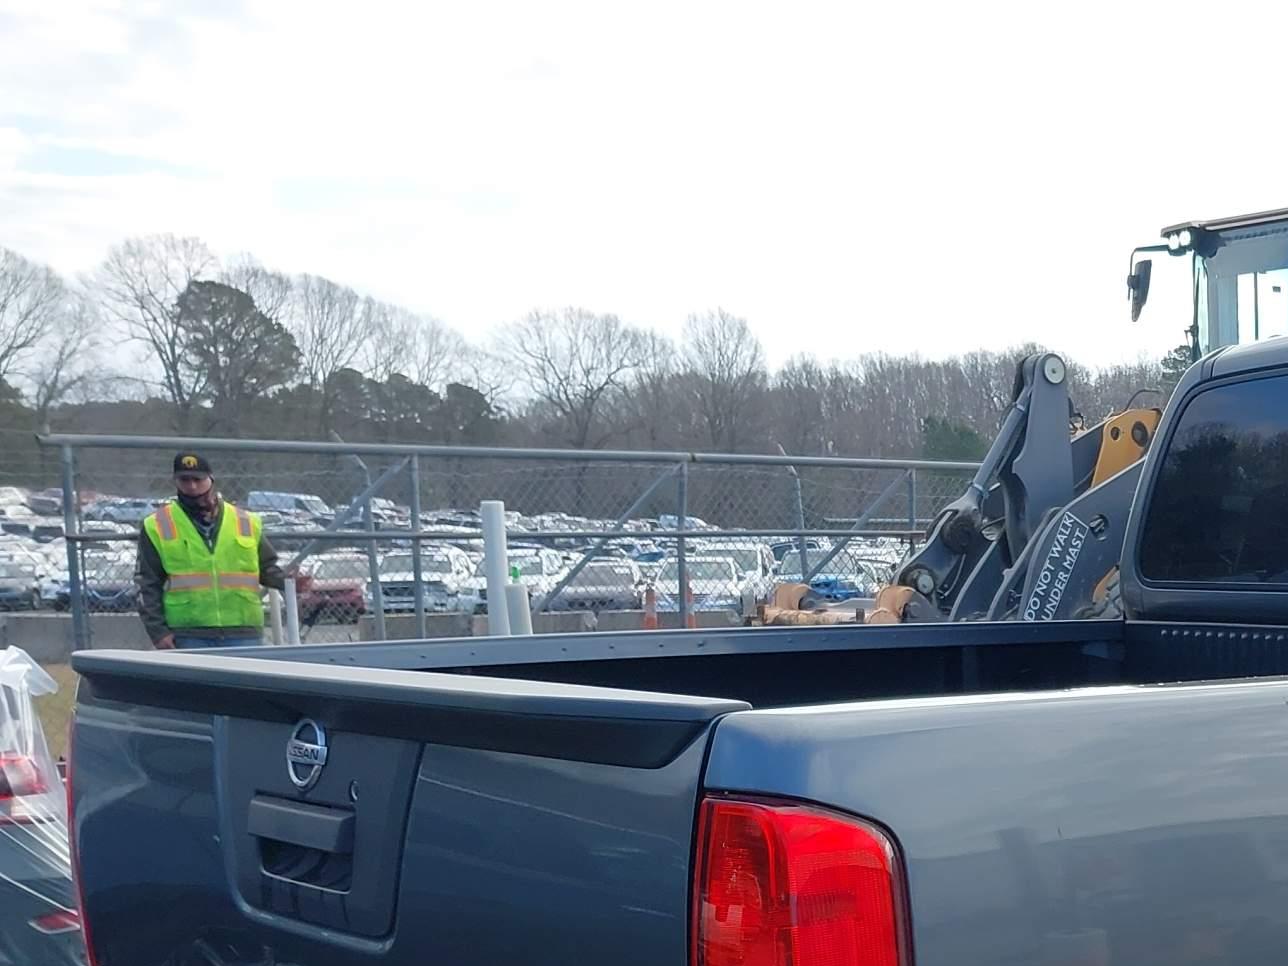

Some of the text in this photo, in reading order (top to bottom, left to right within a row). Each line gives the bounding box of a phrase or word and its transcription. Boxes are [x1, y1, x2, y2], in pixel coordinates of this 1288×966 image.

[1025, 513, 1075, 620] DO NOT WALK
[1041, 527, 1085, 620] UNDER MAST
